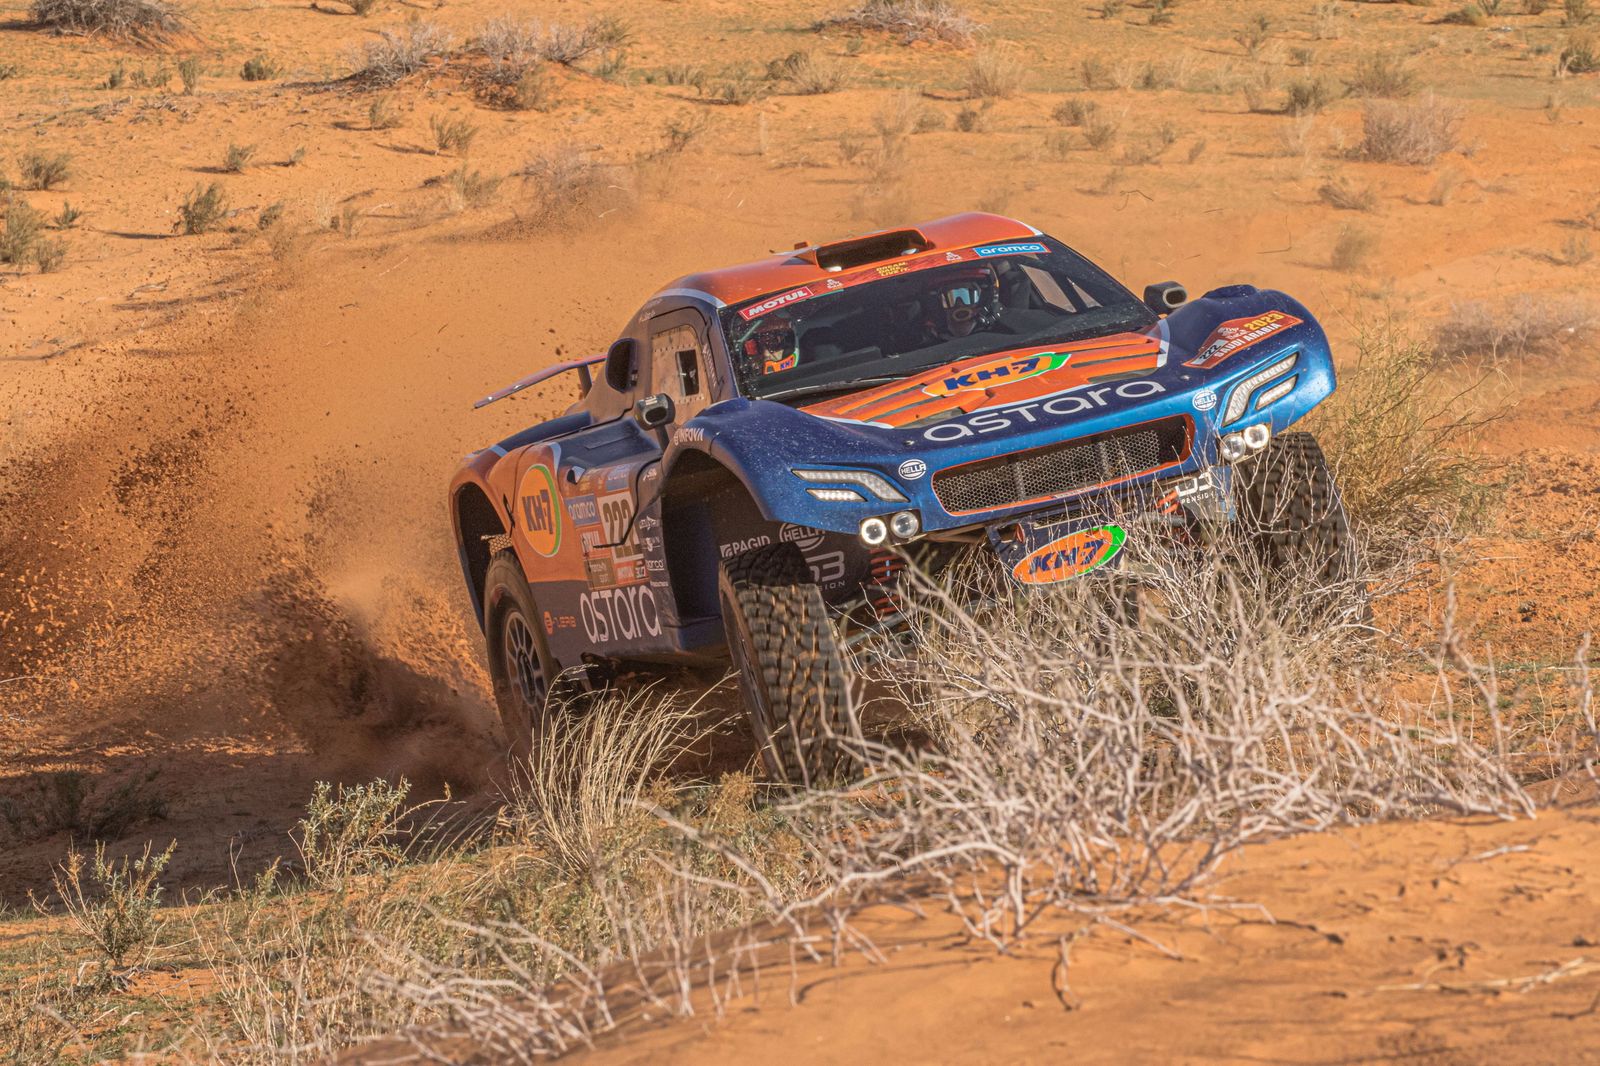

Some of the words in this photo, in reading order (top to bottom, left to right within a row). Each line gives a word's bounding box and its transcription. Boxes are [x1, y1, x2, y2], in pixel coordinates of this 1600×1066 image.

[981, 244, 1040, 255] aramco
[748, 289, 808, 316] MOTUL
[1244, 313, 1285, 330] 2023
[1214, 339, 1246, 358] SAUDI
[1244, 323, 1282, 342] ARABIA
[1199, 344, 1222, 360] 222
[1194, 393, 1217, 407] HELLA
[900, 462, 926, 477] HELLA
[567, 501, 596, 520] aramco
[602, 499, 642, 558] 222
[783, 526, 826, 542] HELLA
[732, 535, 771, 555] PAGID
